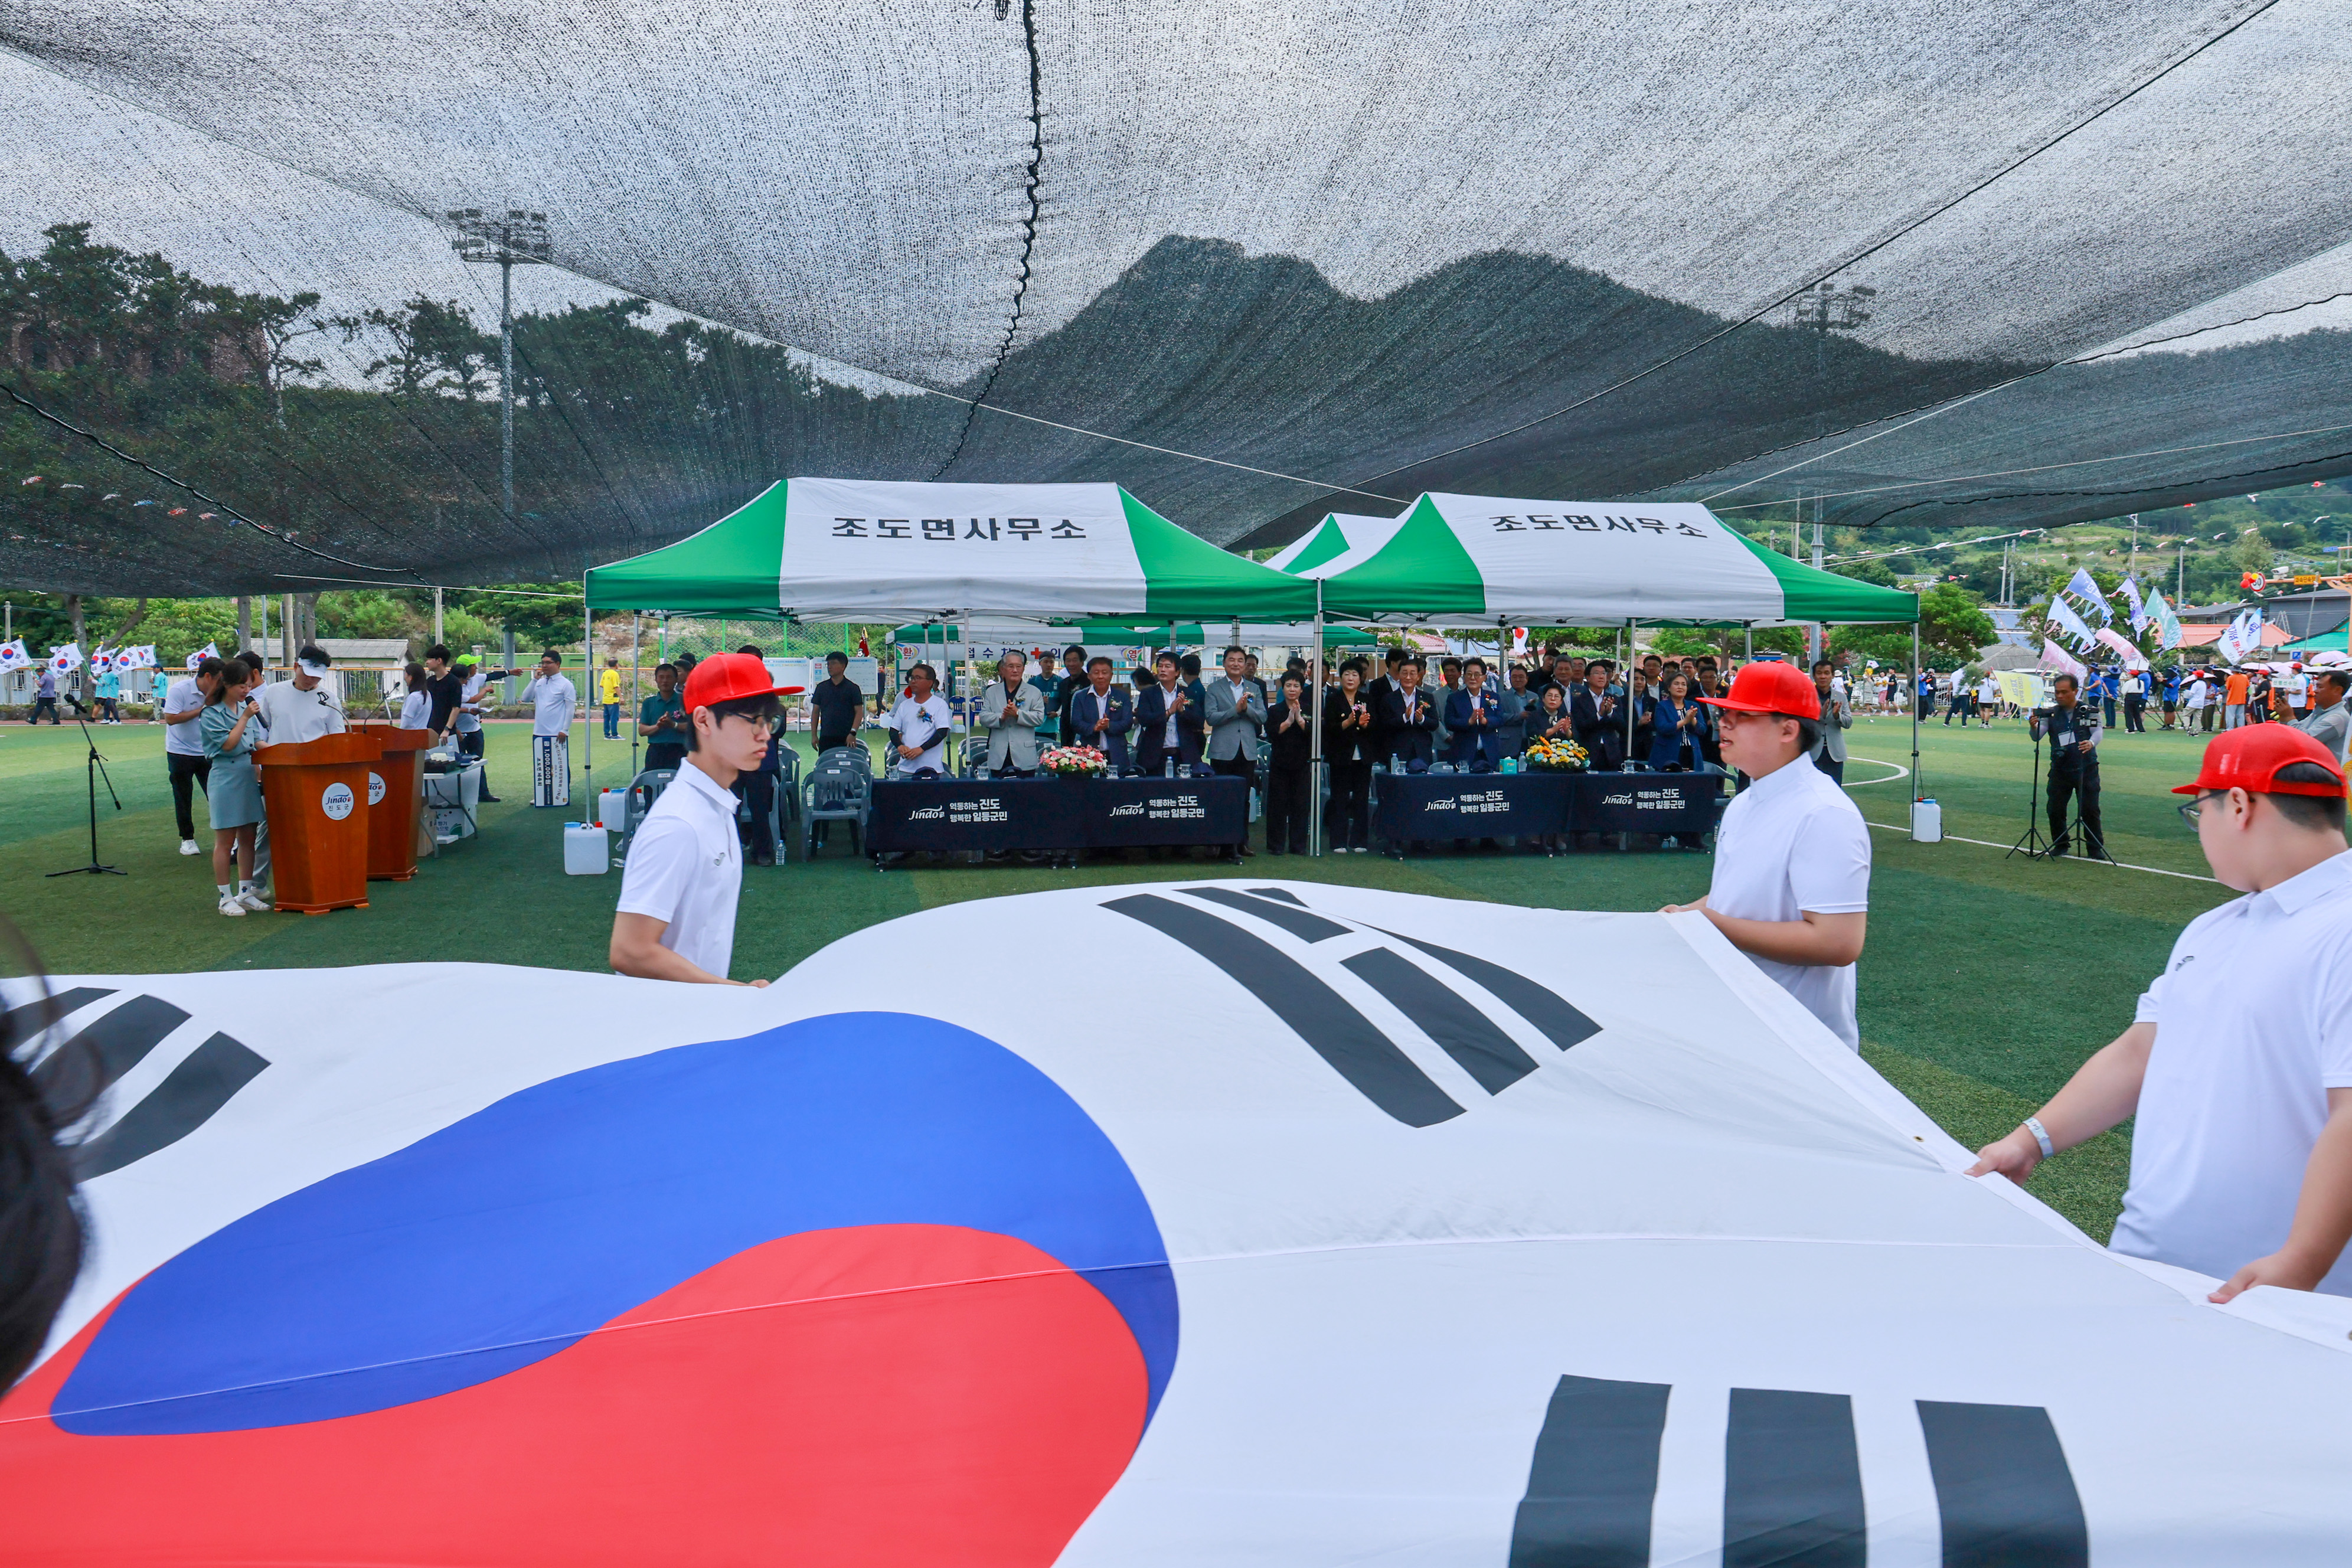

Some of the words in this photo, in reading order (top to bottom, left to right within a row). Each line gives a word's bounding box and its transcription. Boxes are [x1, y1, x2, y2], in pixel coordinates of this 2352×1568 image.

[832, 518, 1087, 541] 조도면사무소
[1489, 515, 1709, 538] 조도면사무소
[326, 794, 348, 805] Jindo
[1460, 794, 1485, 802] 역동하는
[1485, 790, 1504, 801] 진도
[1602, 794, 1630, 805] Jindo
[1662, 788, 1680, 799] 진도
[949, 802, 978, 811] 역동하는
[979, 798, 1001, 810] 진도
[1149, 799, 1177, 807] 역동하는
[1178, 795, 1198, 806] 진도
[1425, 799, 1453, 811] Jindo
[1479, 802, 1510, 812] 일등군민
[1655, 800, 1685, 809] 일등군민
[909, 808, 940, 820] Jindo
[1109, 804, 1141, 816] Jindo
[1171, 808, 1205, 818] 일등군민
[949, 814, 972, 822] 행복한
[972, 811, 1008, 822] 일등군민
